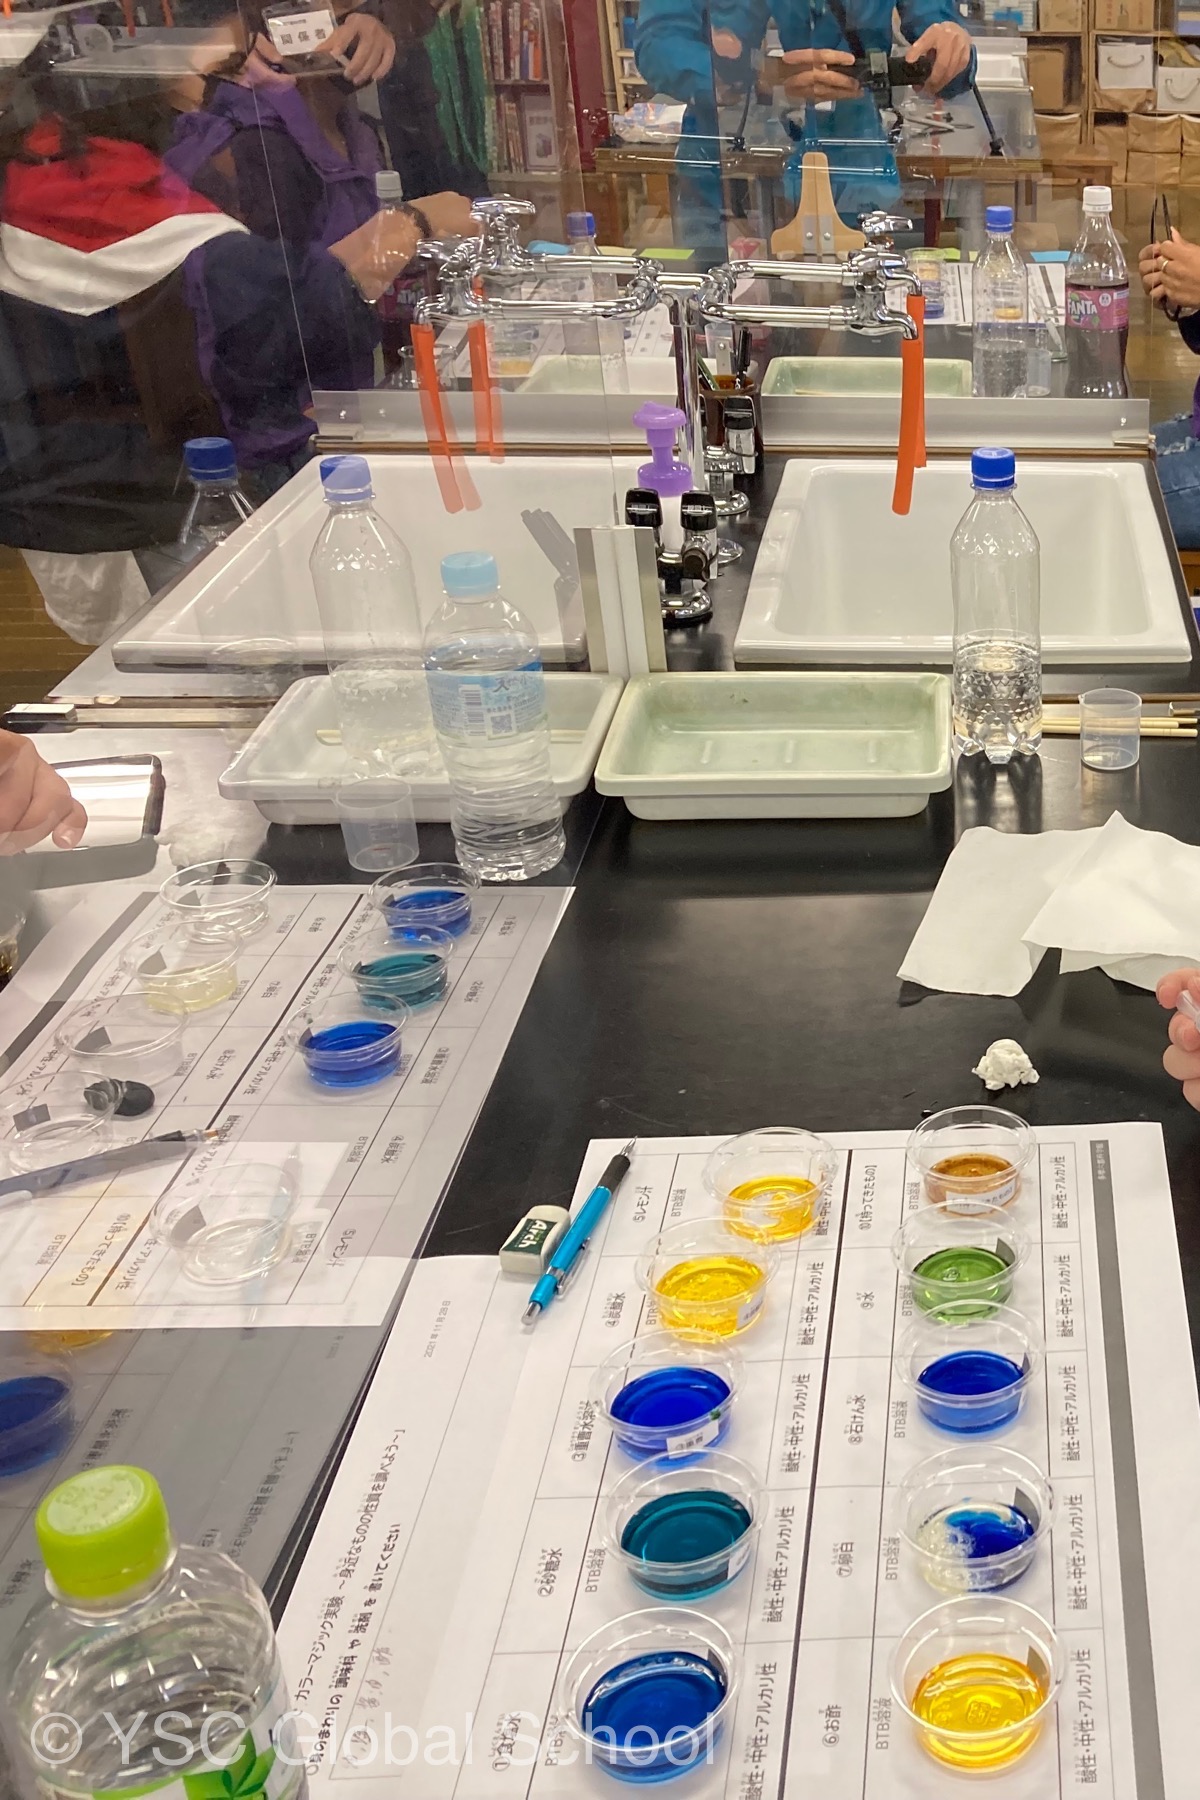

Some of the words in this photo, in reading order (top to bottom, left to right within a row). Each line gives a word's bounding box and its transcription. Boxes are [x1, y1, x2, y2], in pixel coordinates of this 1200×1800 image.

[519, 1220, 547, 1248] Arch
[800, 1261, 824, 1345] 酸性・中性・アルカリ性
[1058, 1255, 1074, 1337] 酸性・中性・アルカリ性
[784, 1373, 811, 1472] 酸性・中性・アルカリ性
[848, 1394, 866, 1445] ⑧石けん水
[1064, 1365, 1080, 1461] 酸性・中性・アルカリ性
[368, 1523, 401, 1593] 書いてください
[537, 1547, 563, 1597] ②砂糖水
[766, 1506, 795, 1622] 酸性・中性・アルカリ性
[837, 1542, 854, 1577] ⑦卵白
[885, 1537, 901, 1580] BTB溶液
[1068, 1494, 1088, 1610] 酸性・中性・アルカリ性
[355, 1612, 373, 1634] 洗剤
[364, 1598, 377, 1607] を
[349, 1638, 361, 1650] や
[334, 1655, 358, 1688] 調味料
[822, 1704, 842, 1747] ⑥お酢
[875, 1697, 892, 1749] BTB溶液
[1076, 1648, 1098, 1784] 酸性・中性・アルカリ性
